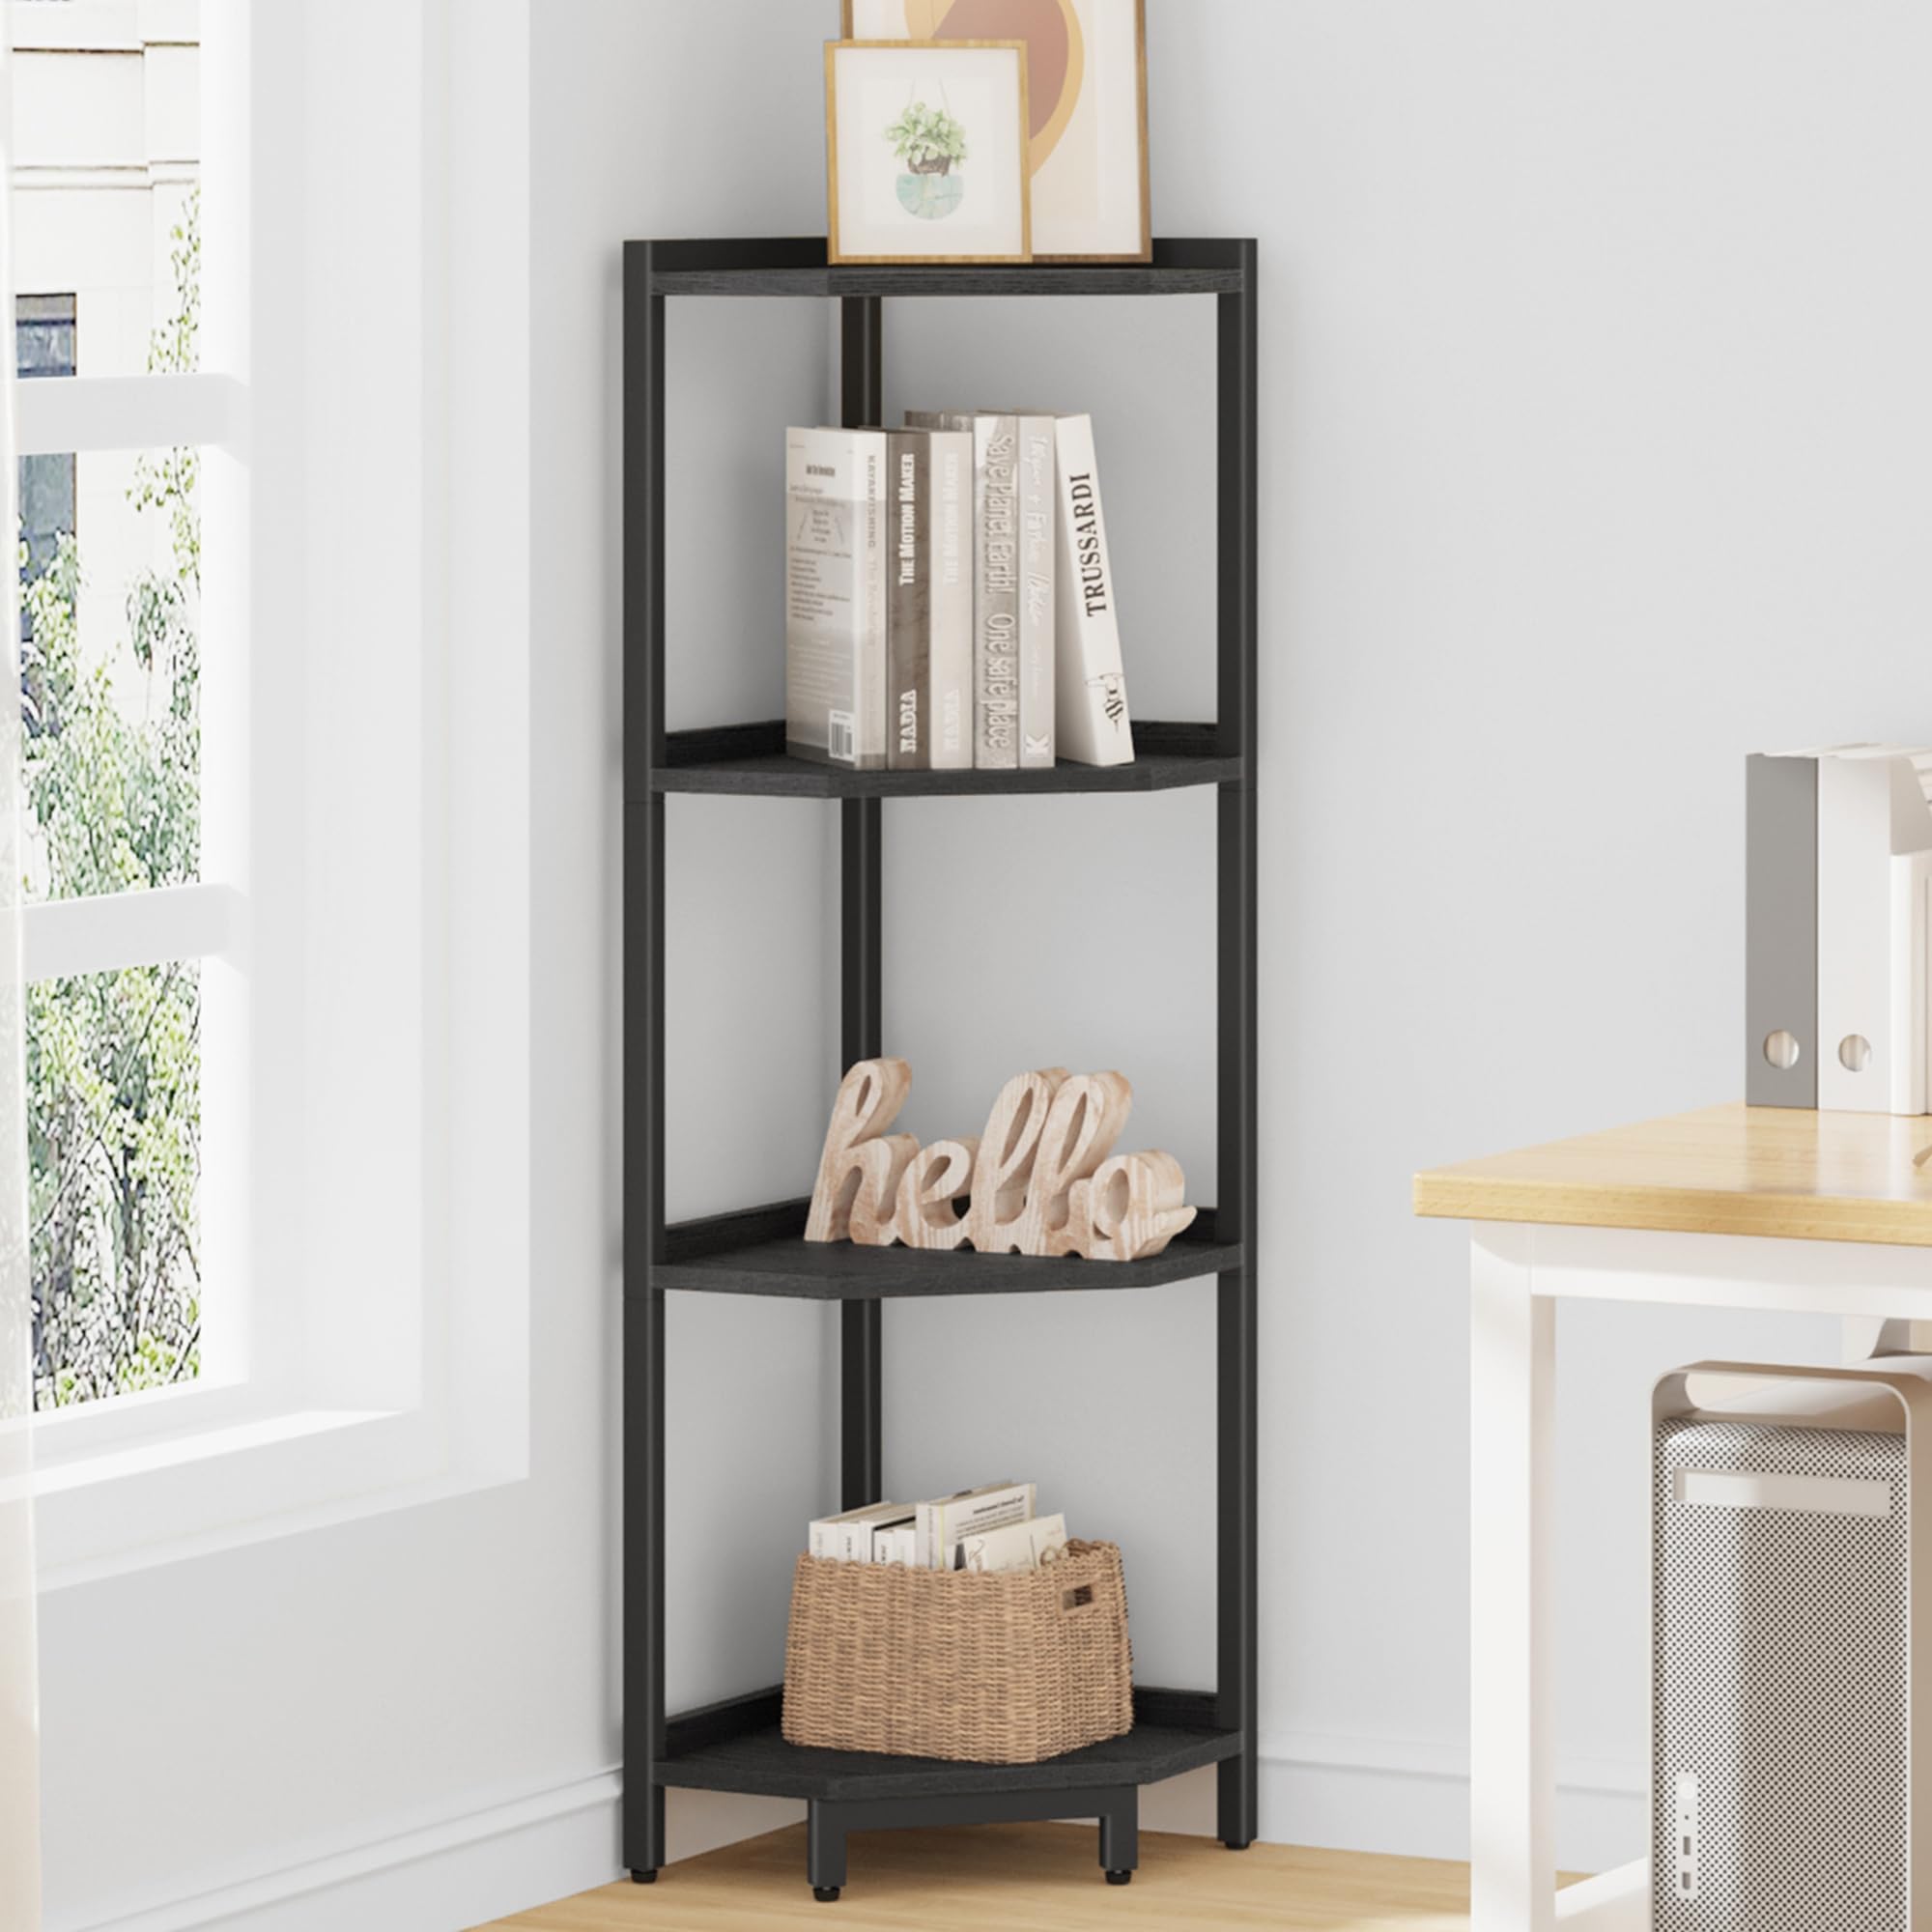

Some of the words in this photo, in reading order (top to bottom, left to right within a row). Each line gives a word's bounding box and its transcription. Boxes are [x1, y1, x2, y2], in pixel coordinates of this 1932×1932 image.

[987, 435, 1014, 479] Save
[986, 482, 1017, 537] Planet
[986, 541, 1017, 595] Earth!
[1069, 472, 1107, 617] TRUSSARDI
[986, 612, 1013, 653] One
[986, 657, 1017, 696] safe
[981, 699, 1017, 750] place
[804, 1058, 1198, 1262] hello
